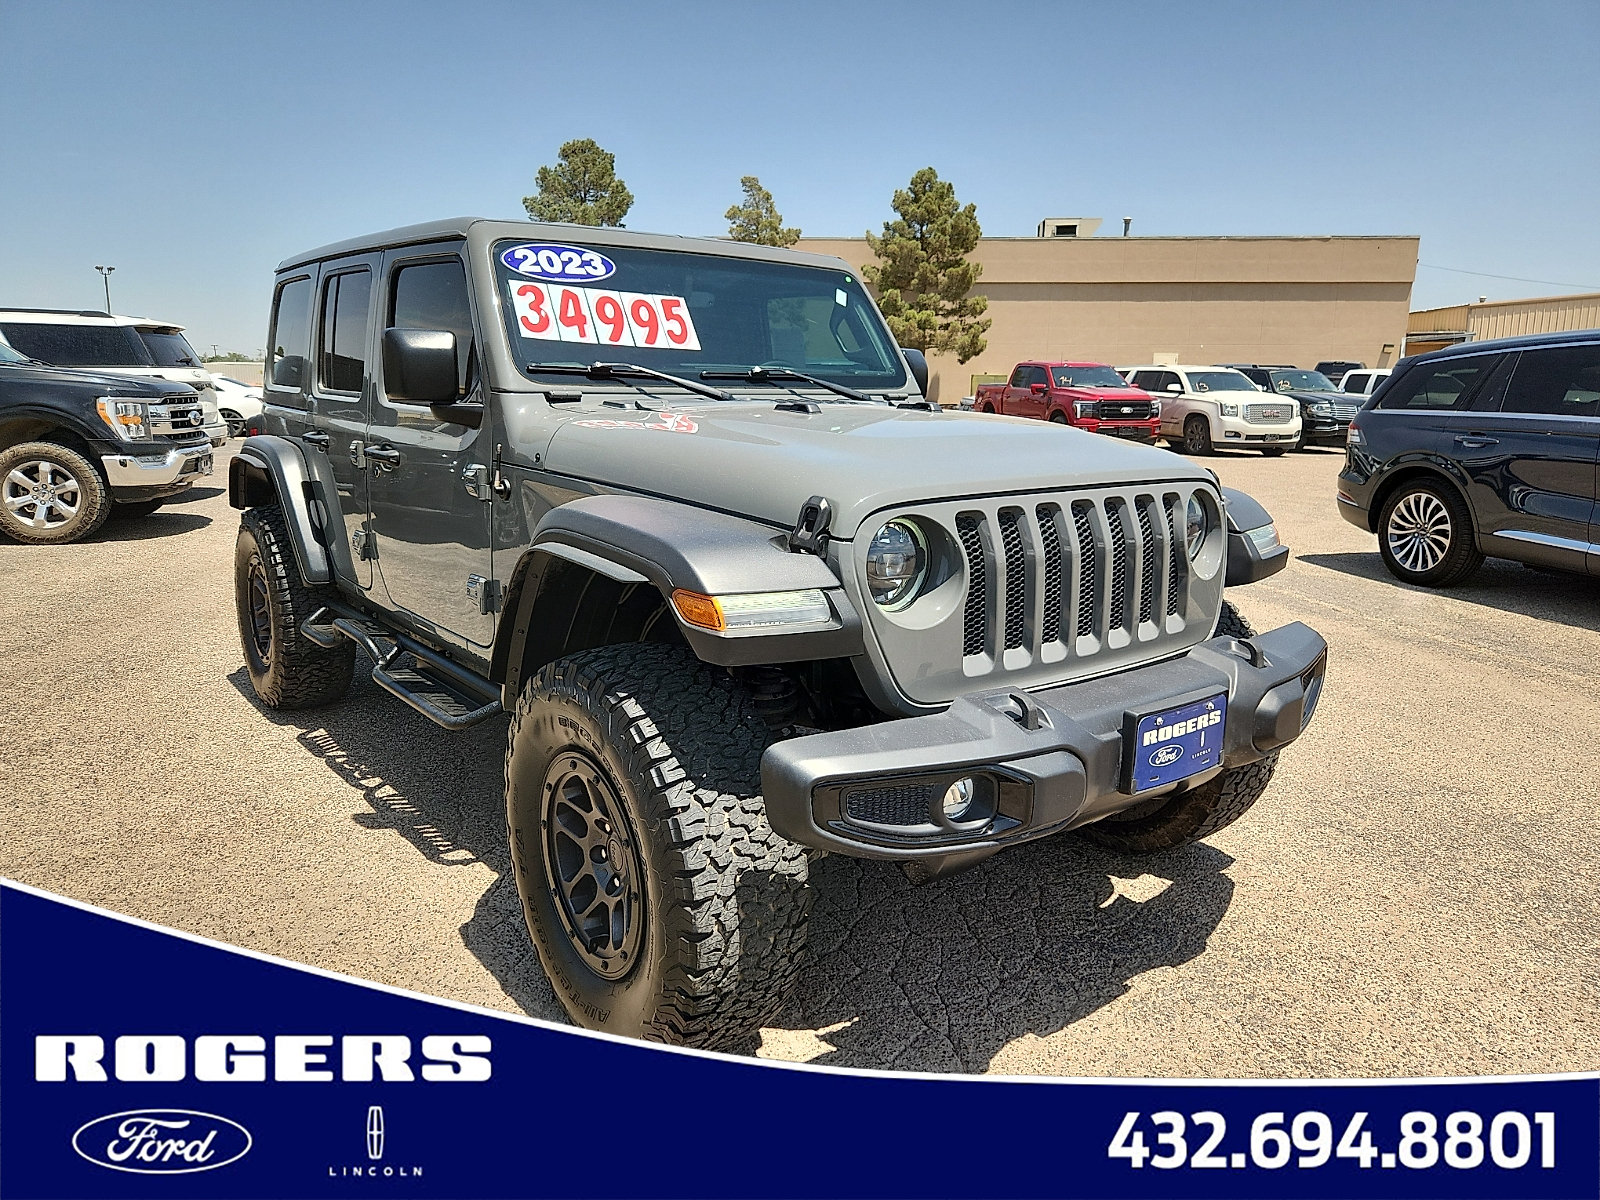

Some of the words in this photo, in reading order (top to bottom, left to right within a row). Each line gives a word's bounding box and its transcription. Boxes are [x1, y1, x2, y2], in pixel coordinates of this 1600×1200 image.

[515, 248, 607, 276] 2023
[516, 284, 690, 345] 34995
[1143, 710, 1221, 746] ROGERS
[1155, 748, 1178, 765] Ford
[1192, 748, 1211, 759] LINCOLN
